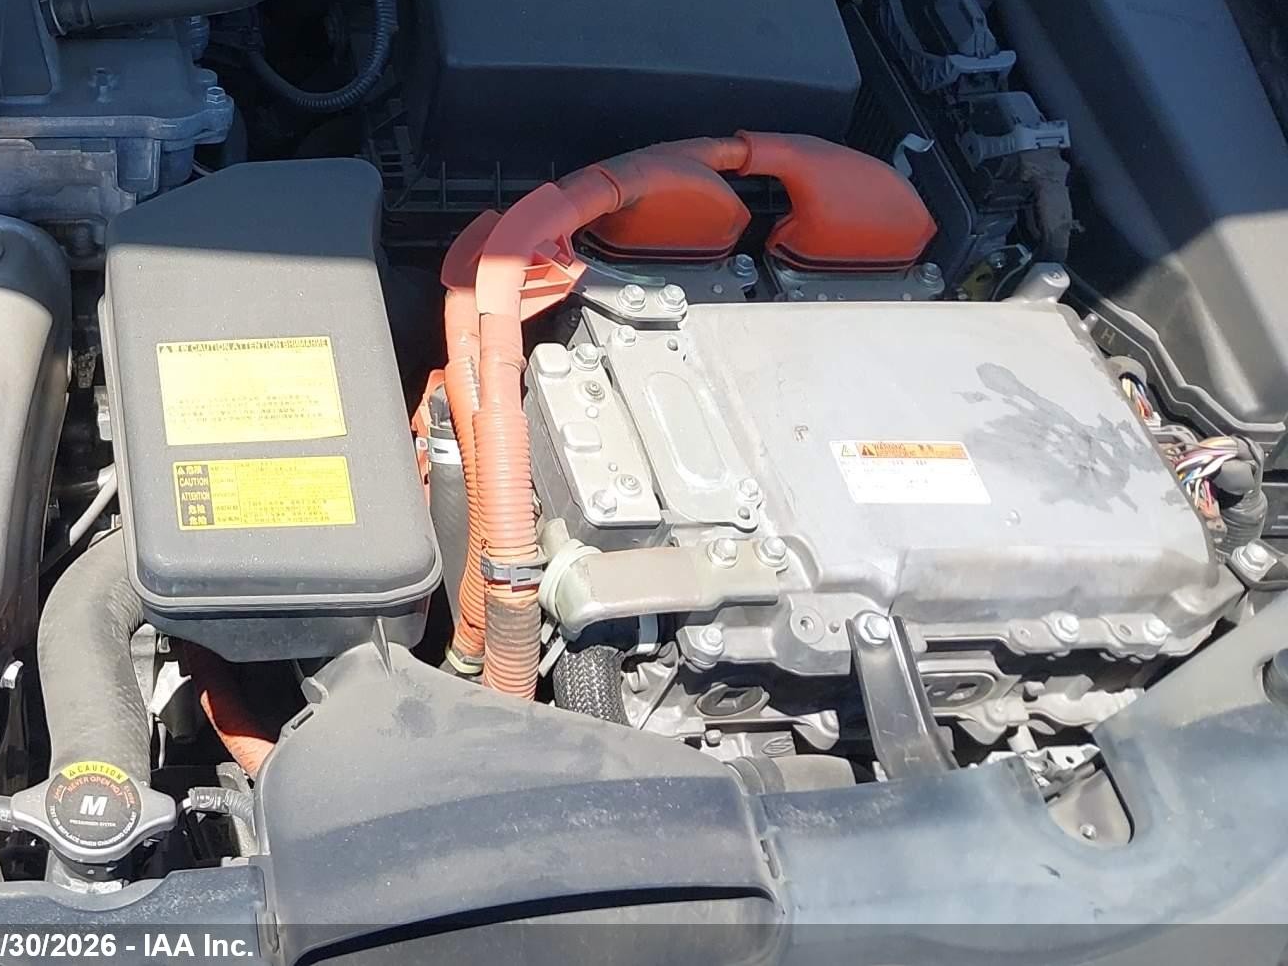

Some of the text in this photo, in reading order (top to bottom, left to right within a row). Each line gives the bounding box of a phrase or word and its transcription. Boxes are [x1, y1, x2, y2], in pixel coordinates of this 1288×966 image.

[179, 477, 208, 487] CAUTION
[77, 764, 125, 780] CAUTION
[67, 776, 89, 792] NEVER
[89, 775, 111, 786] OPEN
[79, 795, 108, 817] M
